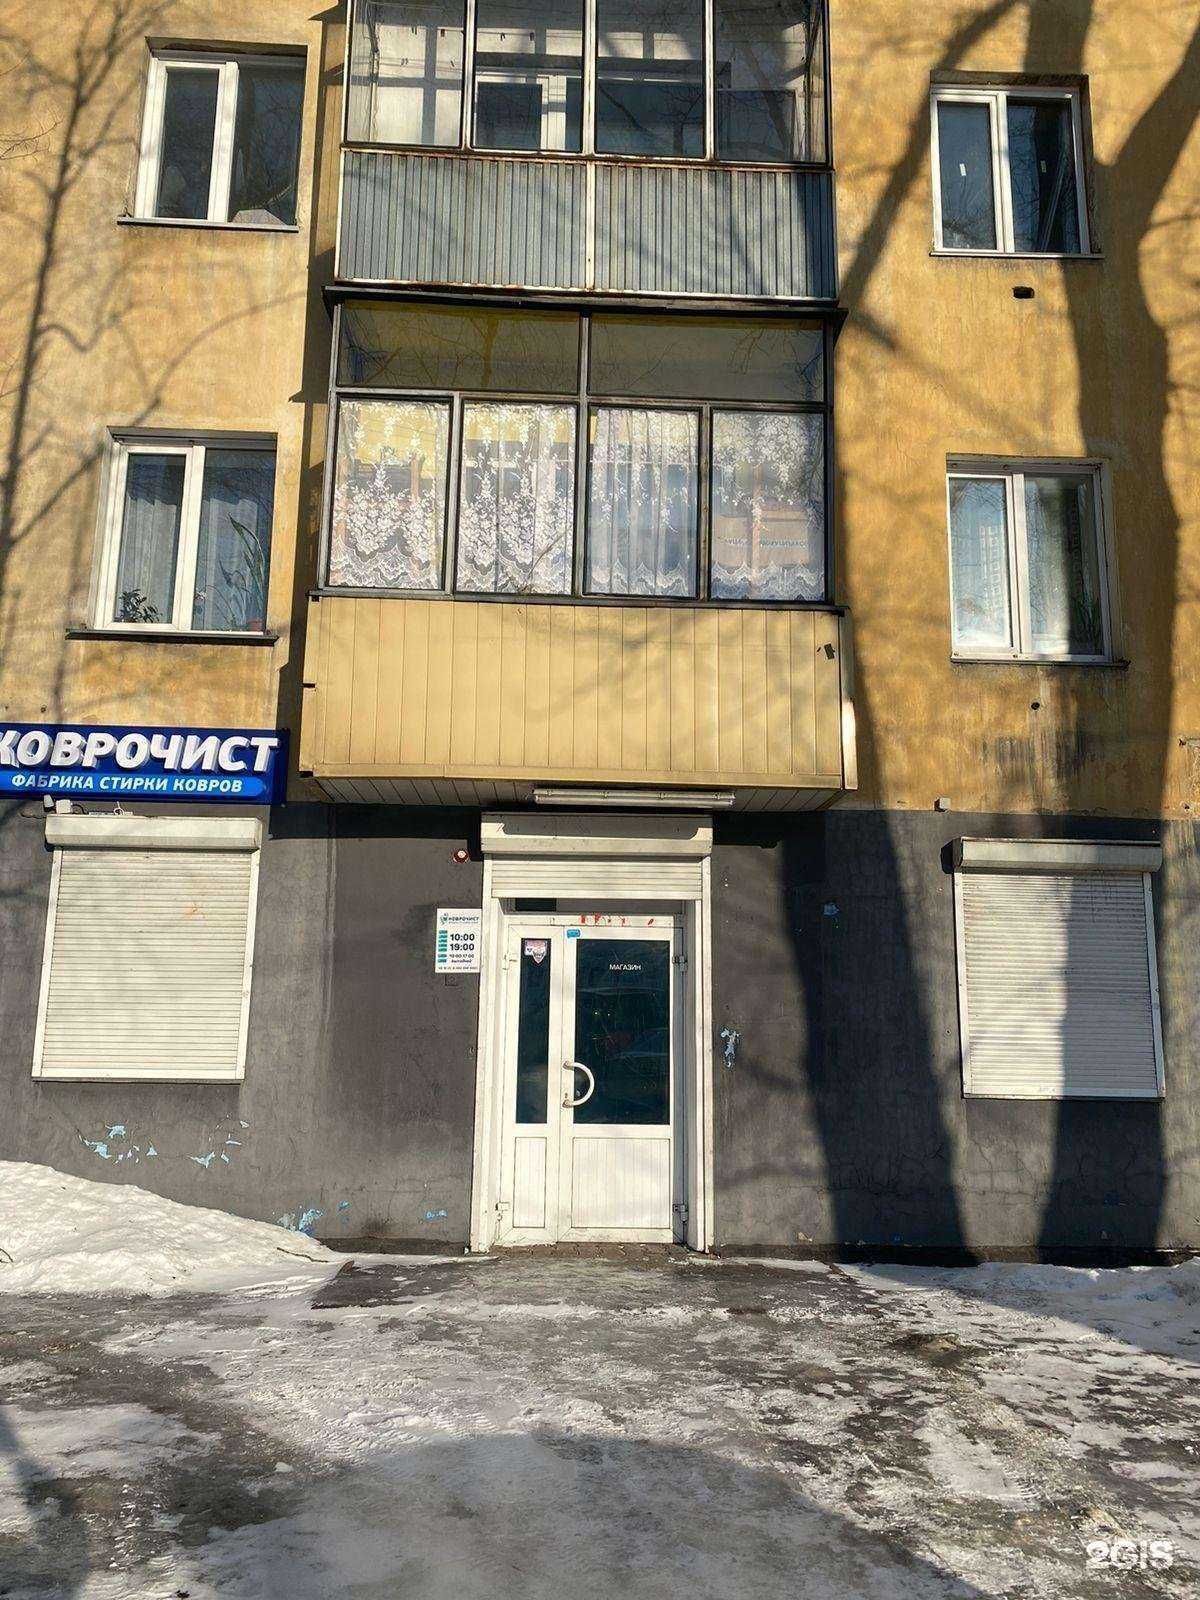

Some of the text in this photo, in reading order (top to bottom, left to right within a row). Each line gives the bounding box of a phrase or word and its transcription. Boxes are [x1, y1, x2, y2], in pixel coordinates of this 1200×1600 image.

[11, 774, 242, 792] ФАБРИКА СТИРКИ КОВРОВ
[450, 933, 475, 941] 10:00
[450, 943, 475, 951] 19:00
